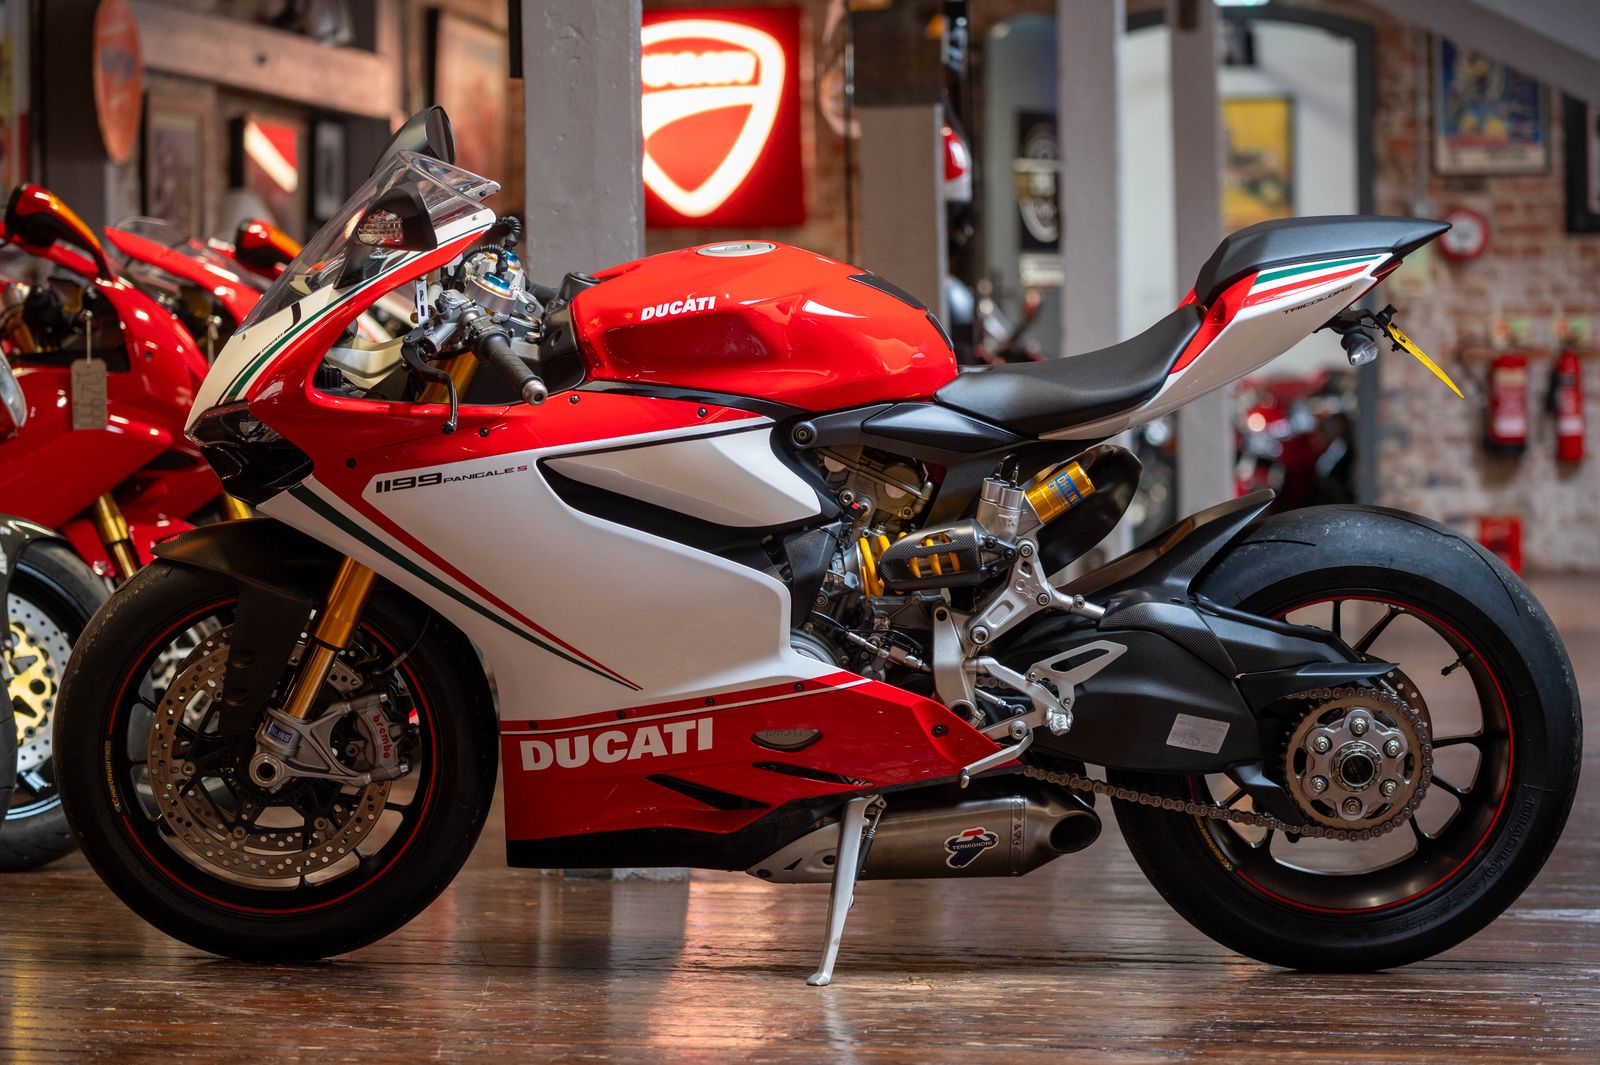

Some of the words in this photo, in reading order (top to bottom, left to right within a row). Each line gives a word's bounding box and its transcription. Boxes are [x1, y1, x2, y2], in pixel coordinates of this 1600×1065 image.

[640, 296, 717, 321] DUCATI
[1283, 284, 1353, 314] TRICOLORE
[375, 472, 442, 493] 1199
[443, 467, 515, 484] PANIGALE
[267, 722, 293, 744] HLINS
[373, 714, 393, 759] brembo
[519, 717, 714, 771] DUCATI
[952, 840, 993, 851] TERMIGNONI
